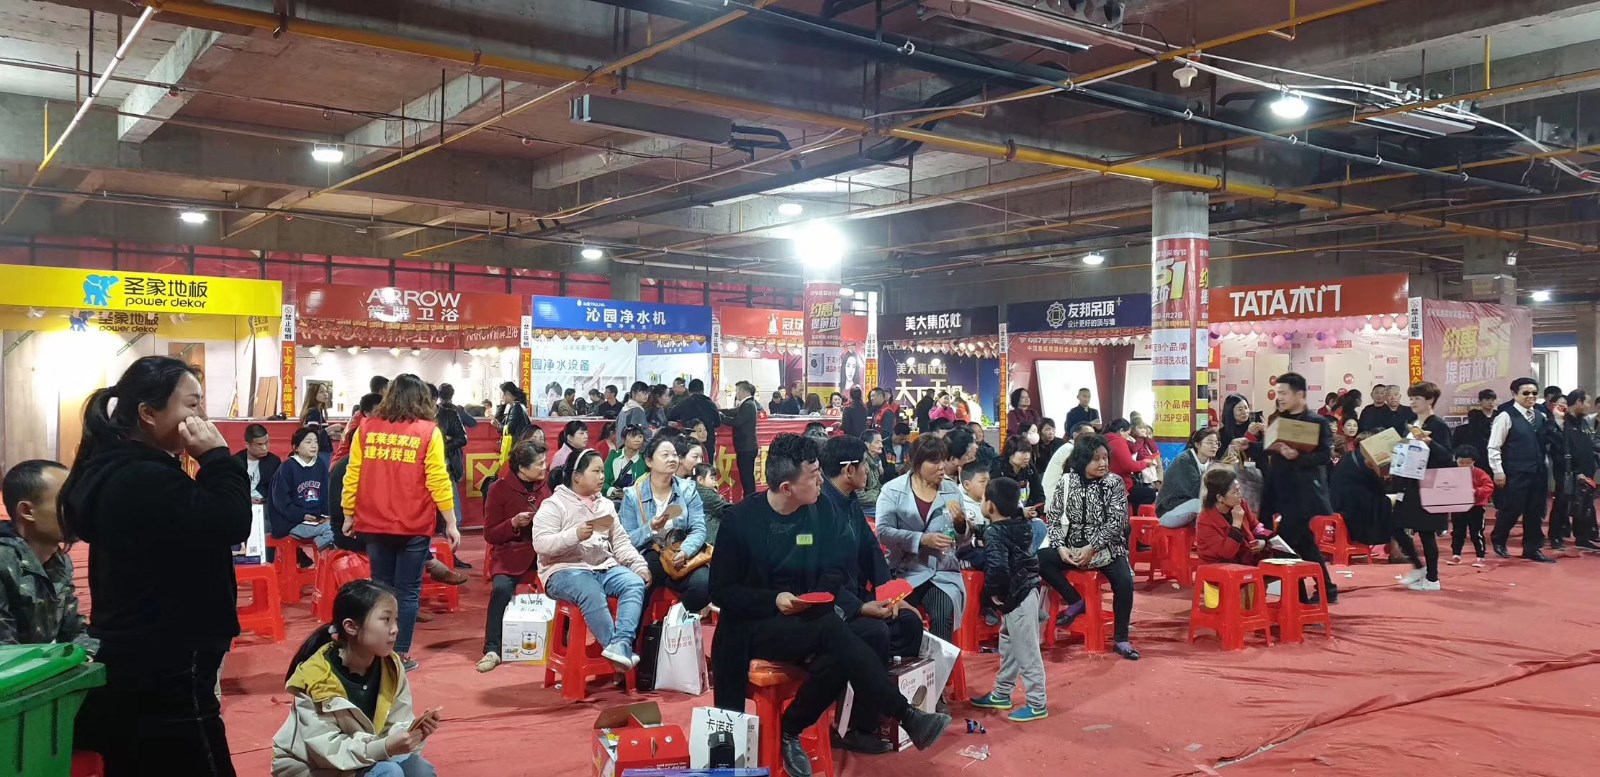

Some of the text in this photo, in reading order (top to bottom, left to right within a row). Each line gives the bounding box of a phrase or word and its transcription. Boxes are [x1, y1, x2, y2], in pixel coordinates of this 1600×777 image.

[124, 277, 208, 298] 圣象地板
[125, 297, 206, 309] power dekor
[366, 288, 461, 308] ARROW
[1229, 284, 1342, 317] TATA木门
[586, 307, 666, 325] 沁园净水机
[1068, 300, 1115, 318] 友邦吊顶
[284, 314, 292, 340] 禁止吸烟
[905, 313, 961, 331] 美大集成灶
[1411, 308, 1419, 338] 禁止吸烟
[365, 432, 421, 449] 富莱美家居
[364, 445, 417, 463] 建材联盟
